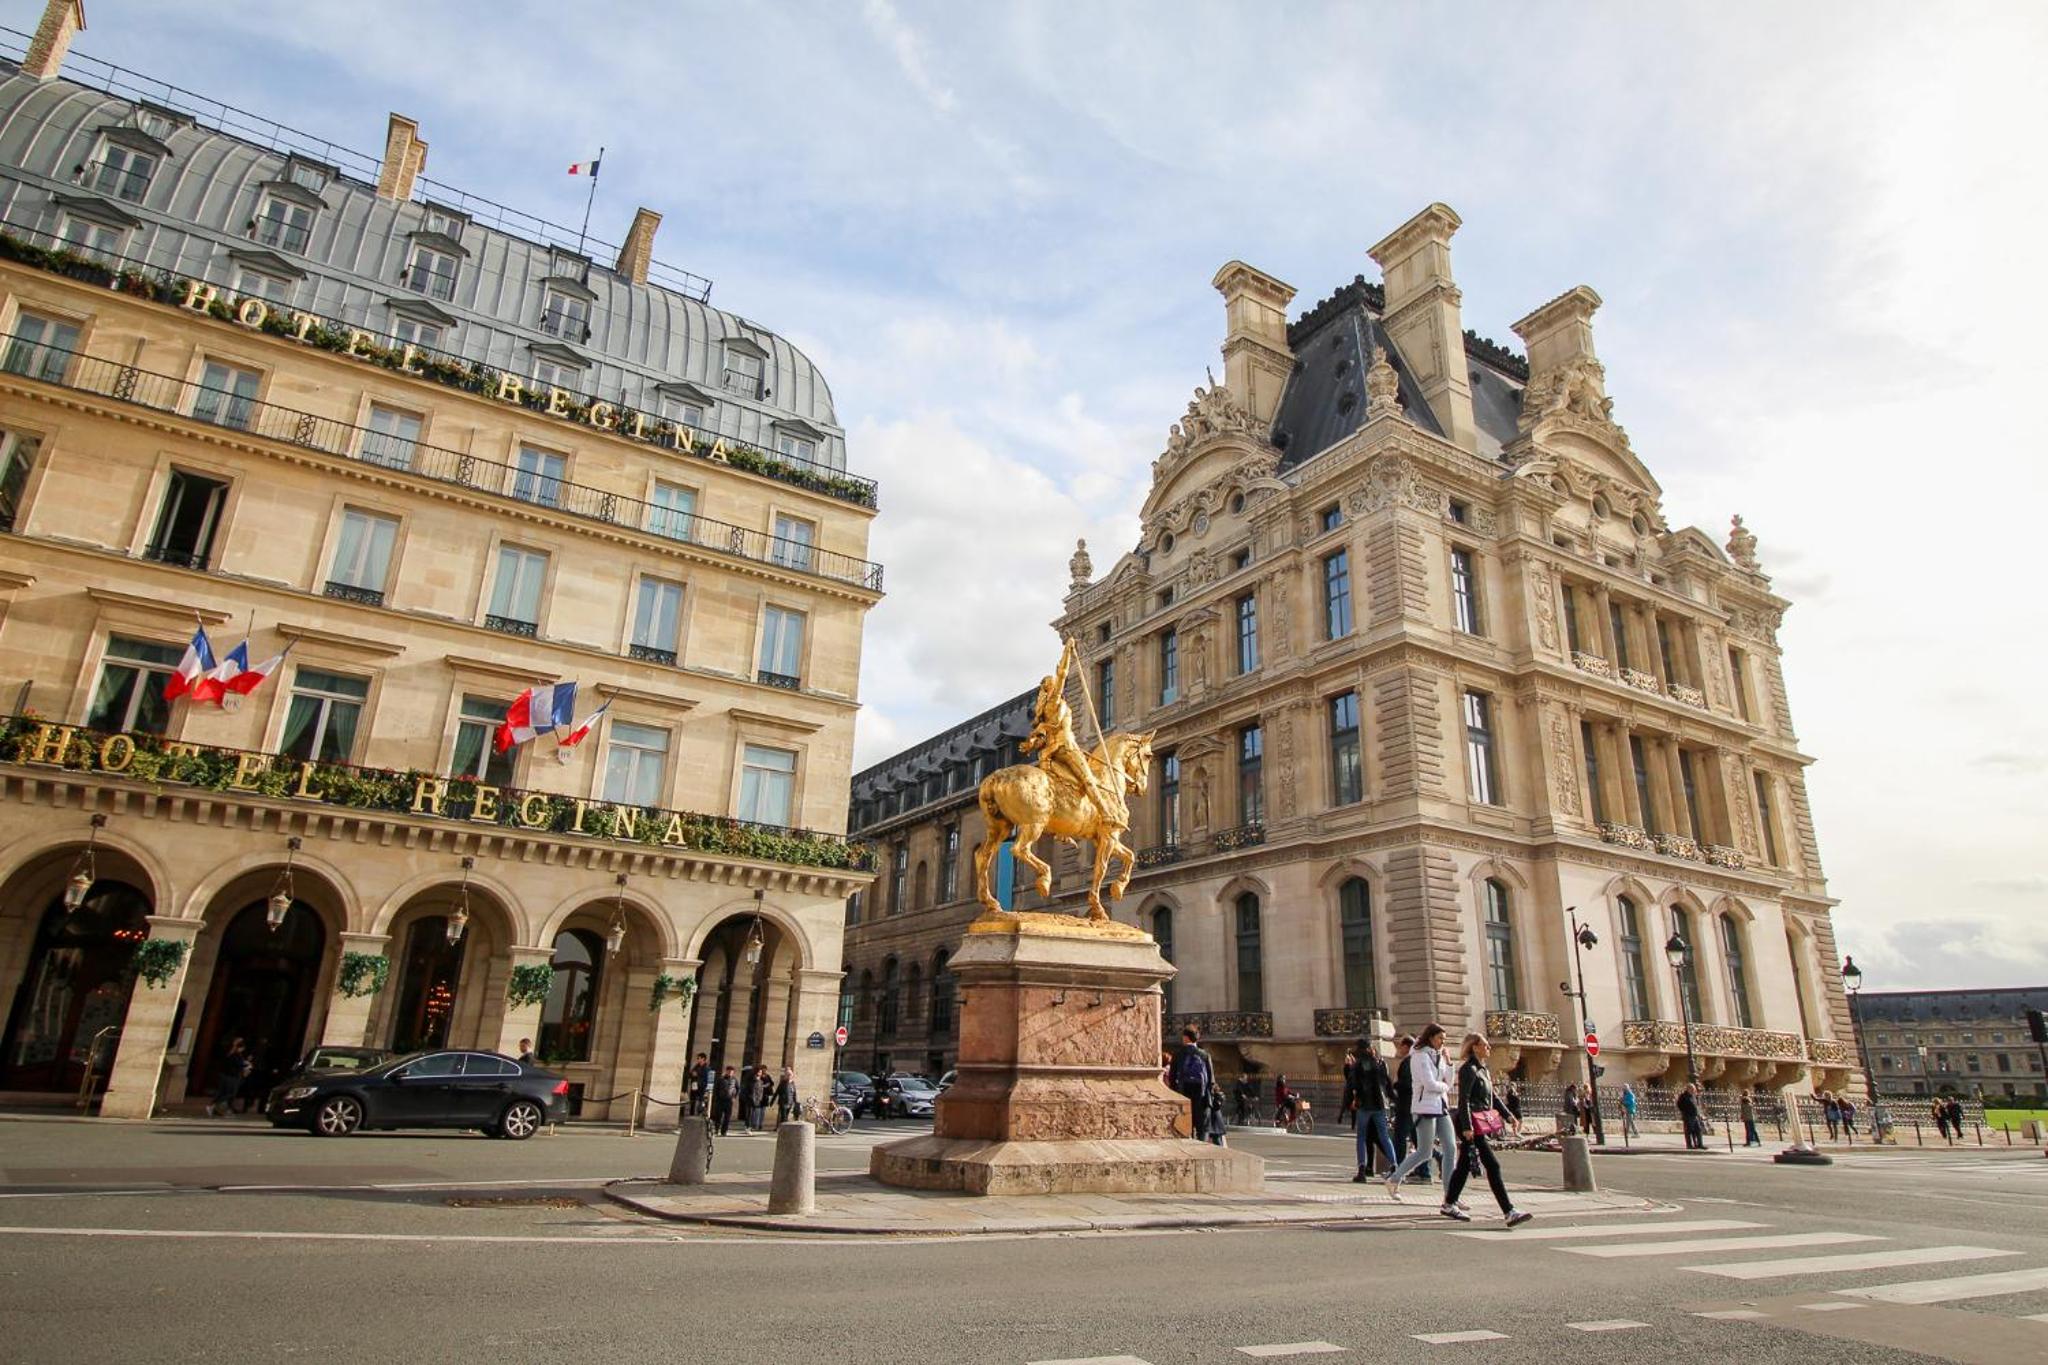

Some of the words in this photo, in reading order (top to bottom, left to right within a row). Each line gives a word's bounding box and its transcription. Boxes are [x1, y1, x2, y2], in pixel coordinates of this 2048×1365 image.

[180, 280, 424, 375] HOTEL
[496, 371, 728, 464] REGINA
[410, 778, 685, 845] REGINA
